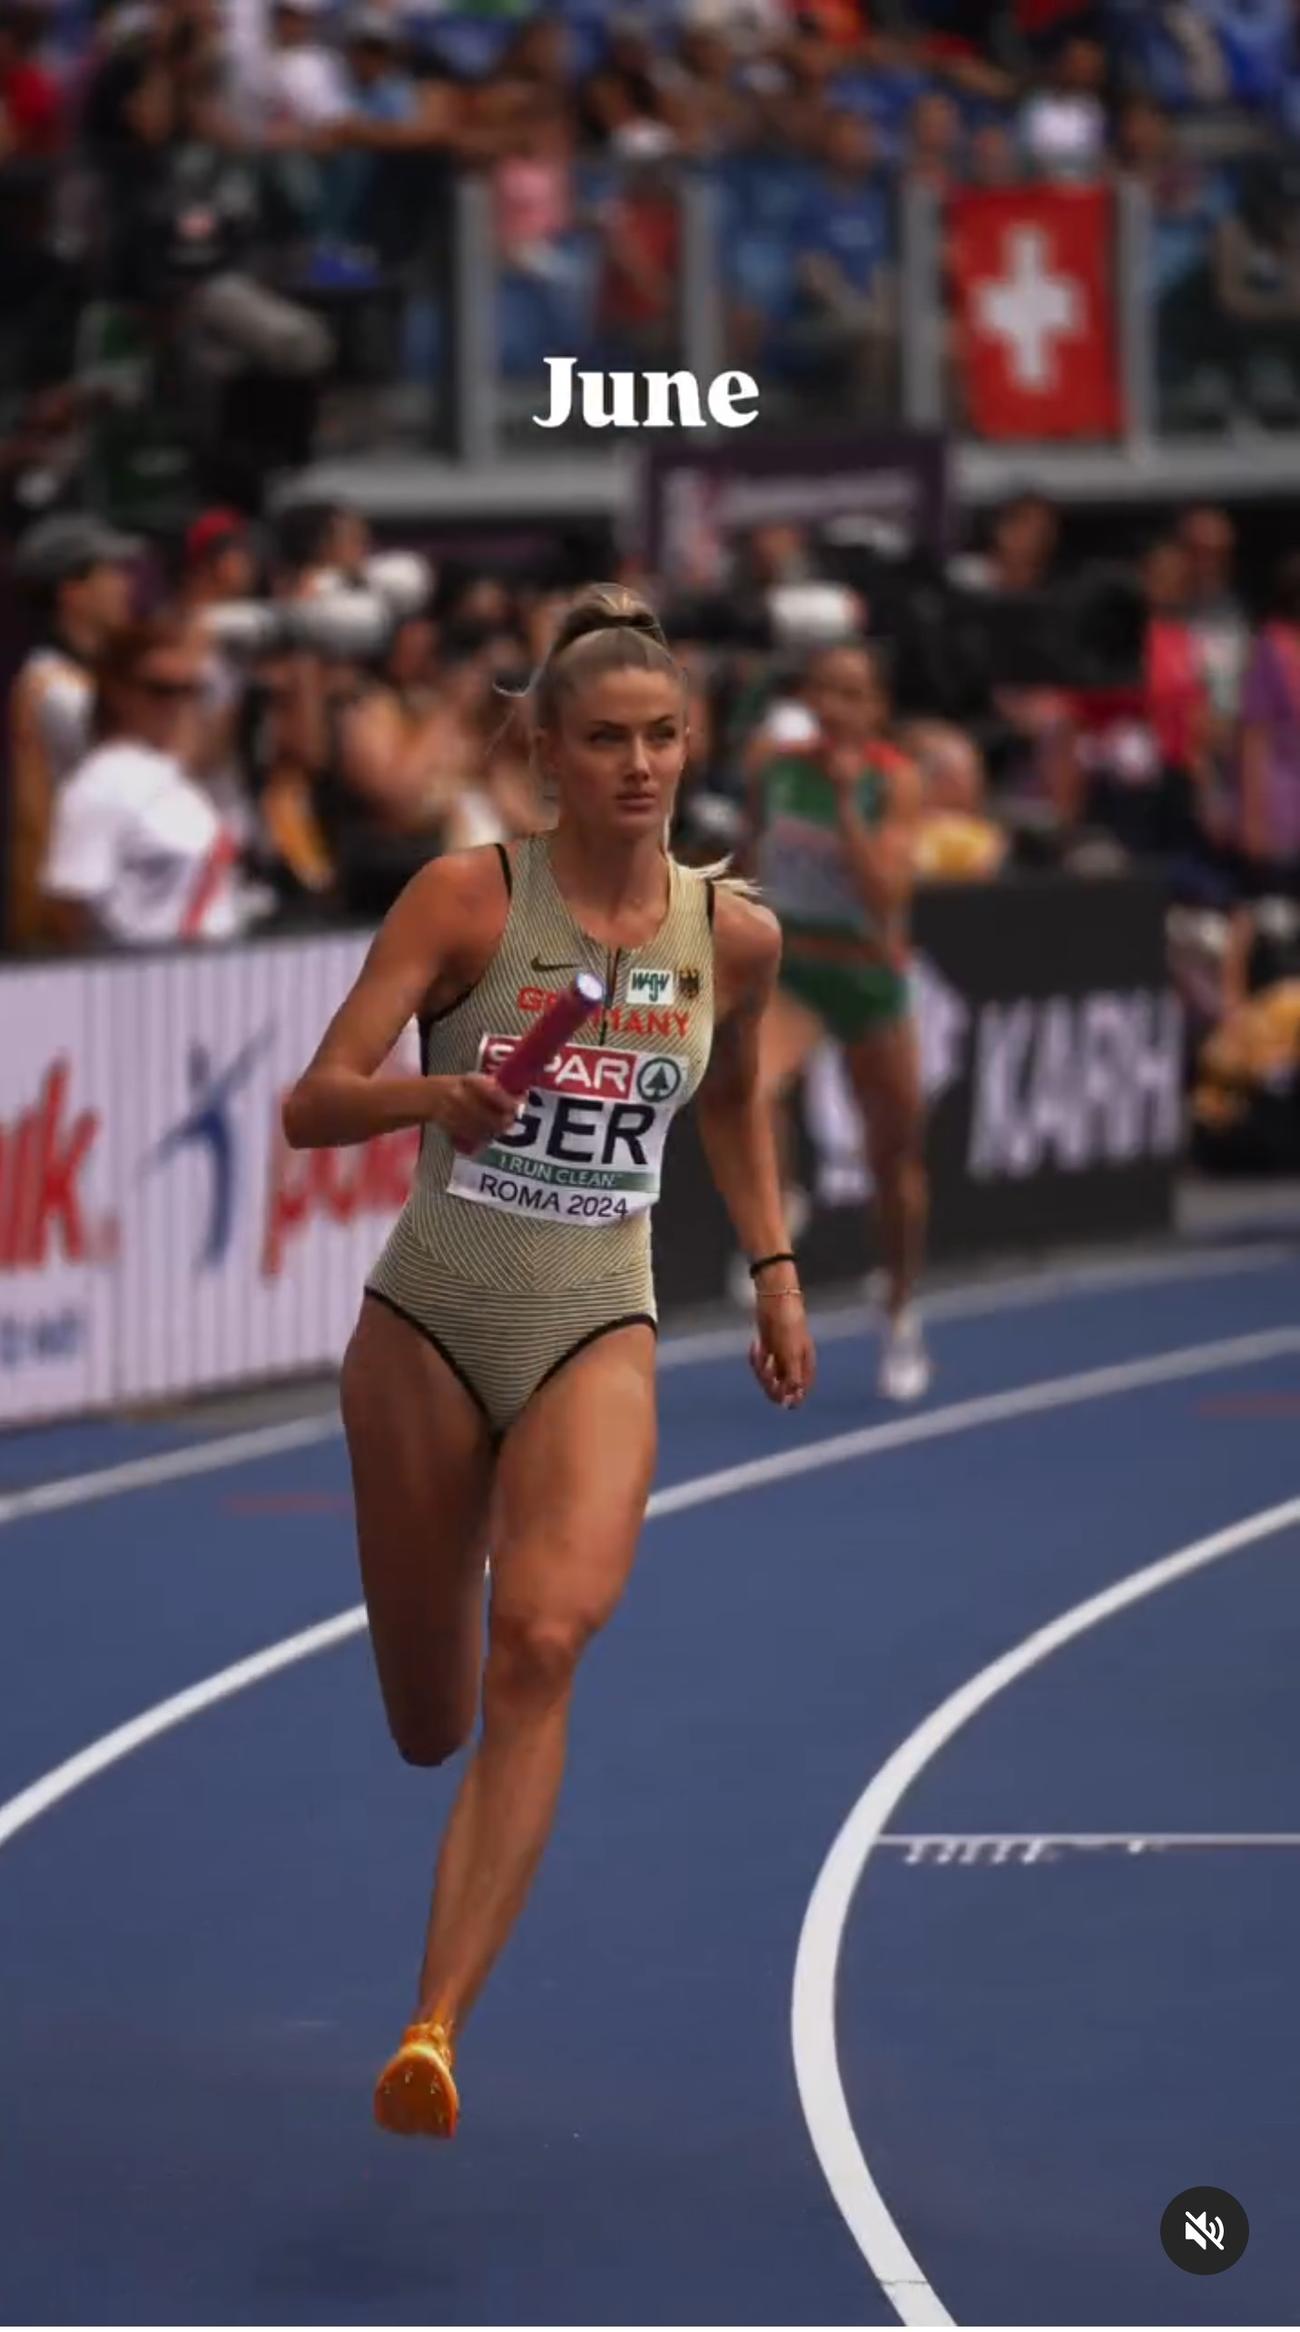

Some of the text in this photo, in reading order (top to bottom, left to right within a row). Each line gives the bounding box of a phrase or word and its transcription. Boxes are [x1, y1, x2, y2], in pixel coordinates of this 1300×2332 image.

[499, 1154, 615, 1187] I RUN CLEAN
[479, 1172, 628, 1219] ROMA 2024
